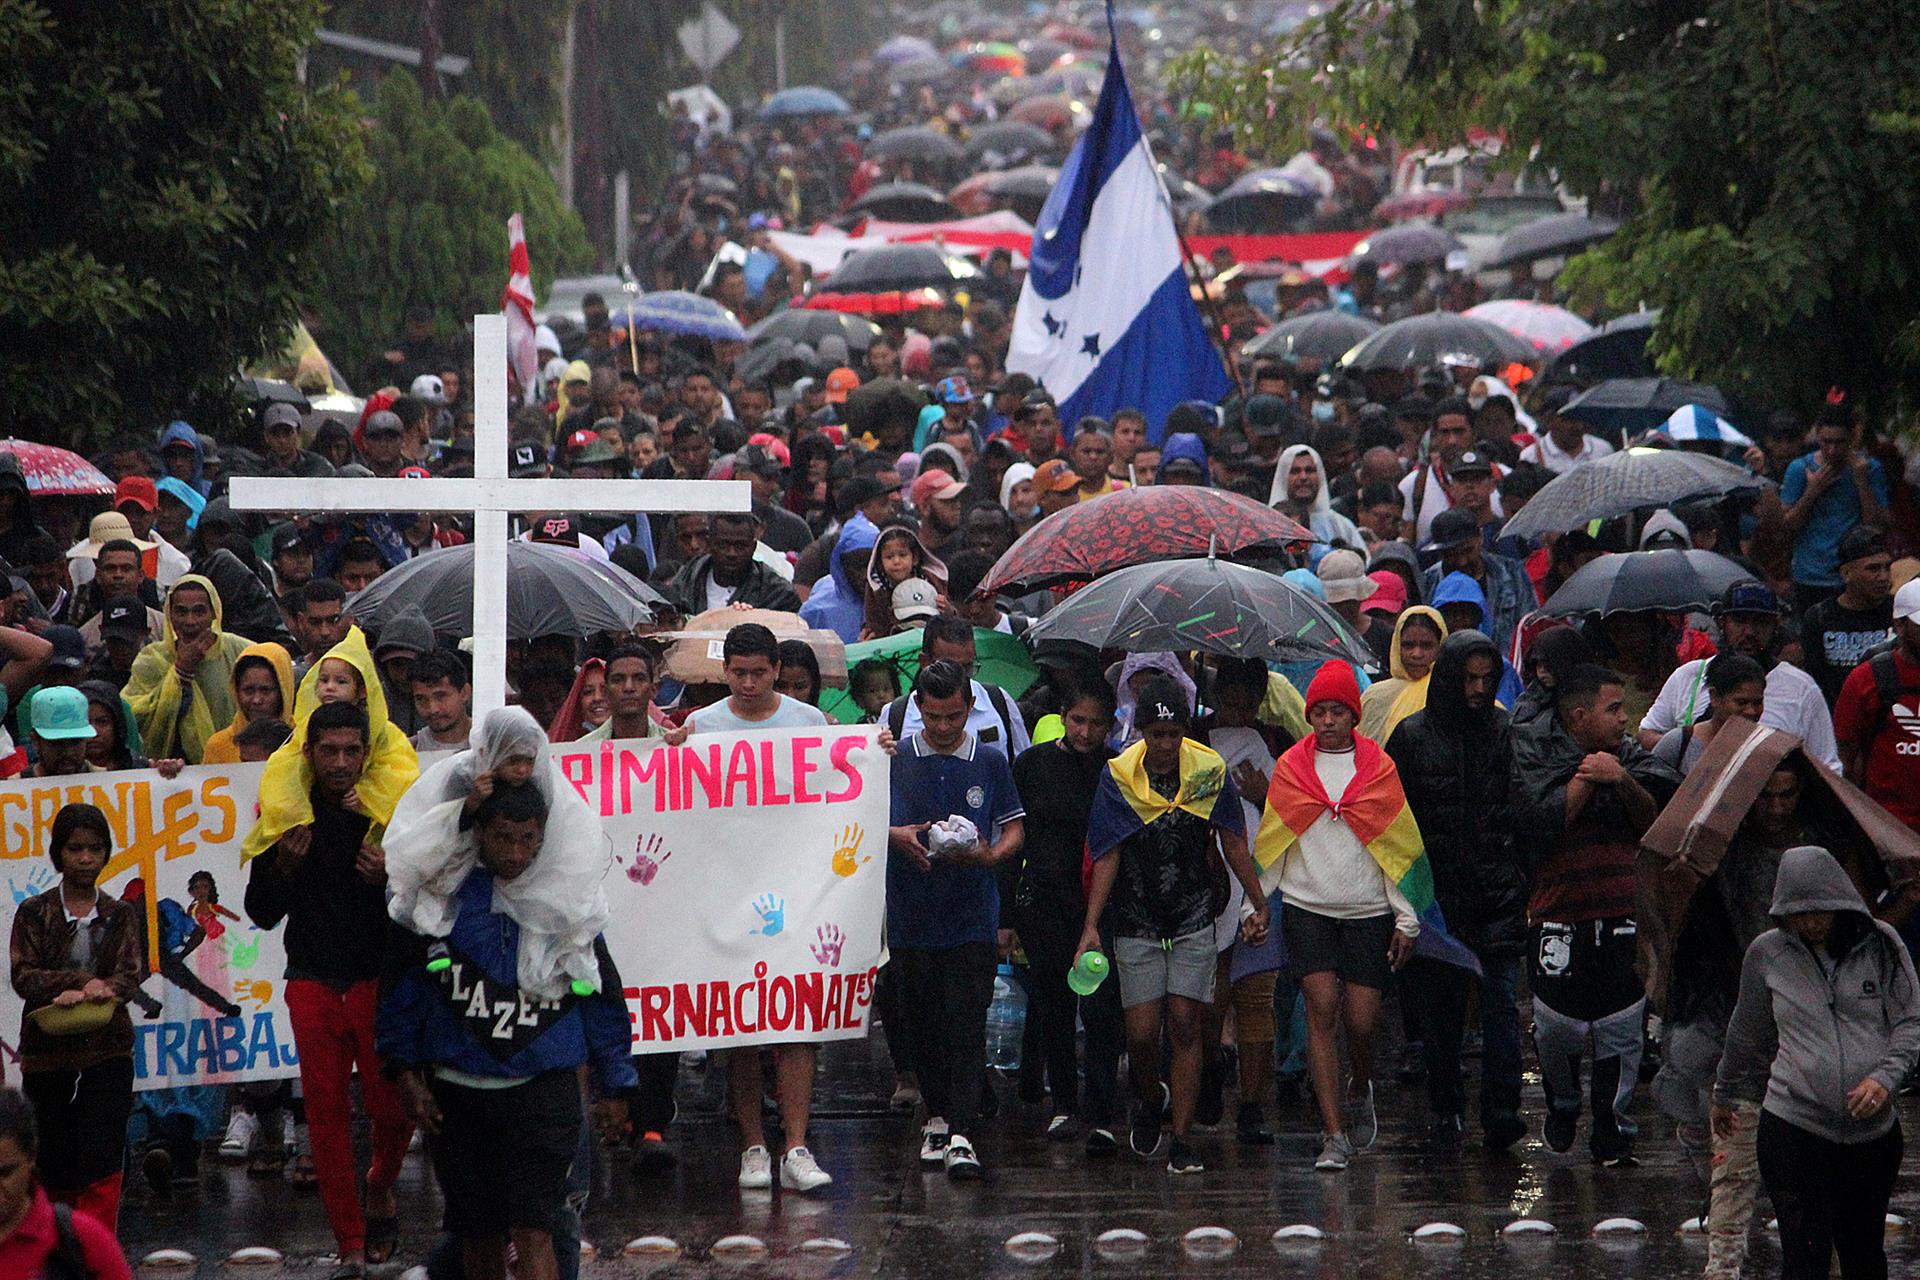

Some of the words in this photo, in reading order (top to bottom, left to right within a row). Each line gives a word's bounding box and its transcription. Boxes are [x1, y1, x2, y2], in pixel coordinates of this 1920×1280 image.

[1155, 702, 1175, 720] LA
[553, 735, 868, 816] RIMINALES
[440, 963, 561, 1040] LAZE
